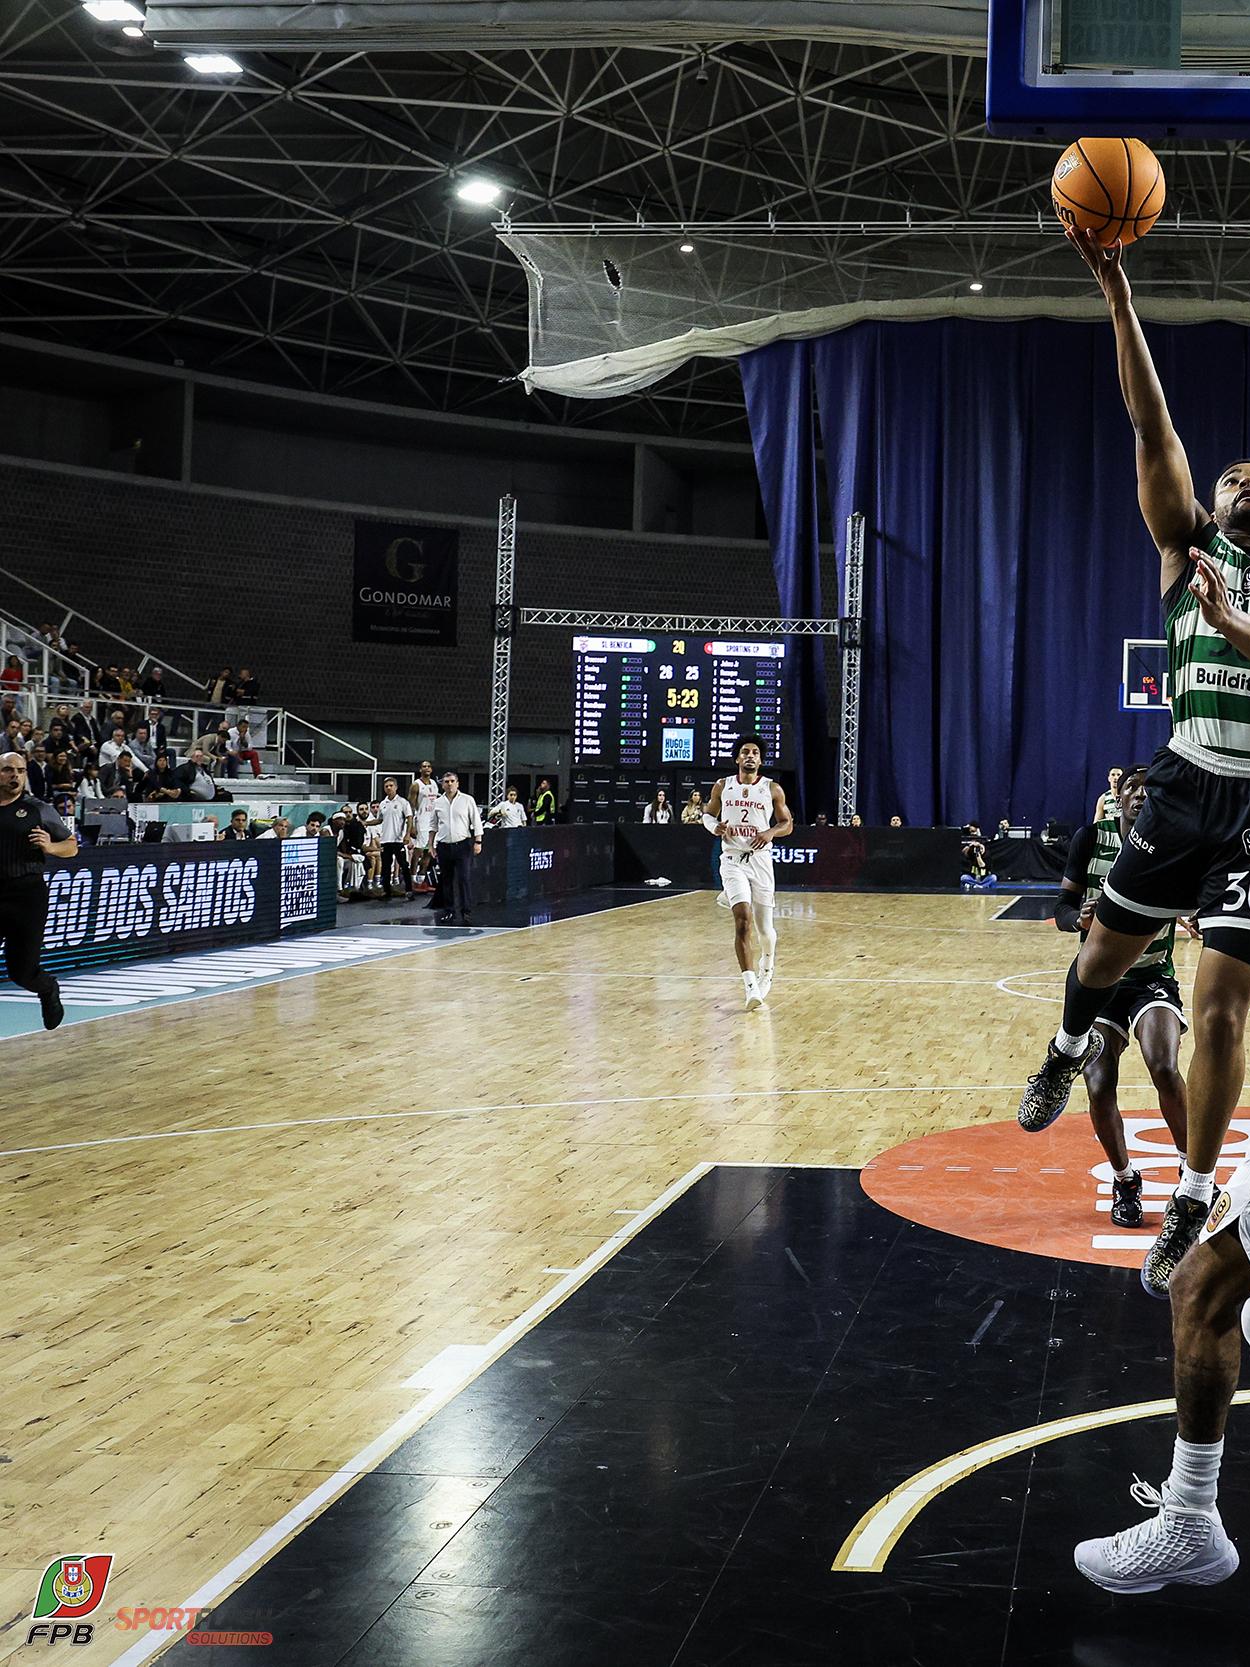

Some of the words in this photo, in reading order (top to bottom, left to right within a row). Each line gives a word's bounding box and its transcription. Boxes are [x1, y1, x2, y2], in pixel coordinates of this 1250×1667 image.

[359, 586, 452, 608] GONDOMAR
[685, 665, 699, 680] 25
[667, 688, 699, 708] 5:23
[665, 738, 683, 748] HUGO
[665, 749, 690, 759] SANTOS
[735, 800, 765, 810] BENFICA
[741, 809, 749, 823] 2
[770, 848, 817, 863] RUST
[94, 864, 158, 943] DOS
[159, 857, 259, 934] SANTOS
